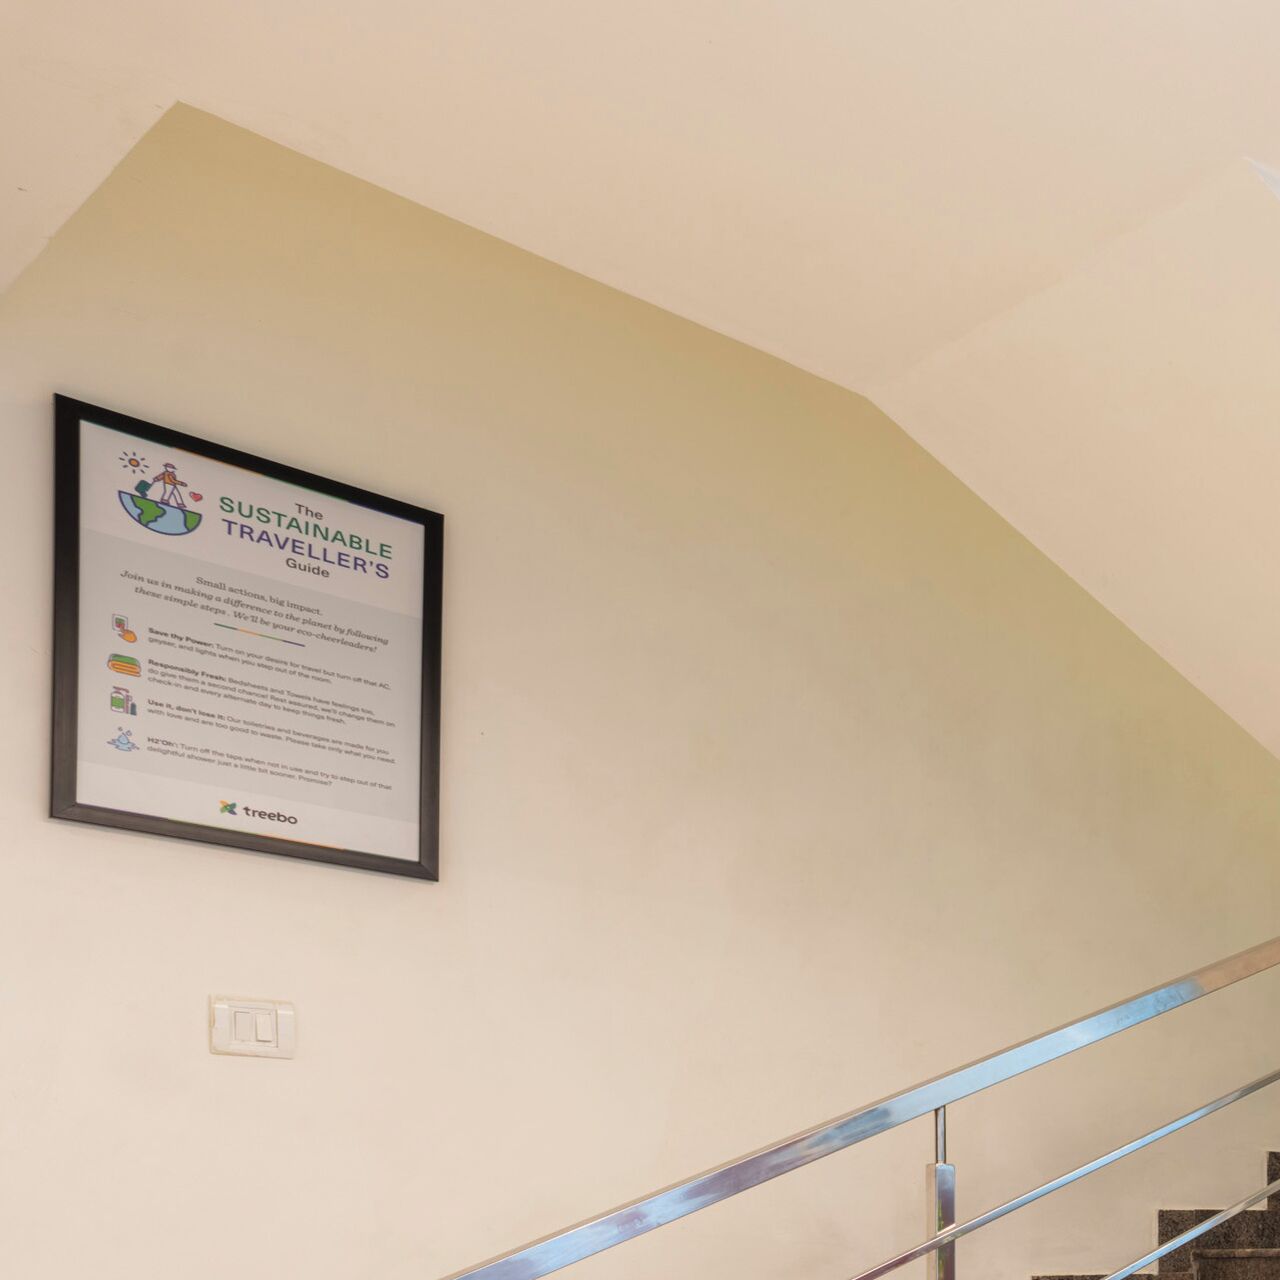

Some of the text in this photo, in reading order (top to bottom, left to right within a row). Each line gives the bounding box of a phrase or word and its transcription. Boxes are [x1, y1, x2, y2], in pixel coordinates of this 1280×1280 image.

[220, 497, 391, 558] SUSTAINABLE
[295, 503, 323, 520] The
[223, 519, 388, 578] TRAVELLER'S
[285, 557, 329, 577] Guide
[120, 570, 144, 582] Join
[161, 581, 172, 589] in
[174, 585, 213, 600] making
[223, 597, 272, 614] difference
[285, 613, 300, 622] the
[301, 618, 332, 630] planet
[333, 624, 345, 634] by
[345, 628, 388, 645] following
[134, 586, 162, 598] these
[164, 595, 198, 608] simple
[233, 610, 258, 623] We'll
[259, 617, 271, 626] be
[272, 622, 295, 632] your
[296, 629, 377, 652] eco-cheerleaders!
[196, 576, 320, 615] Small actions, big impact.
[243, 806, 297, 824] treebo
